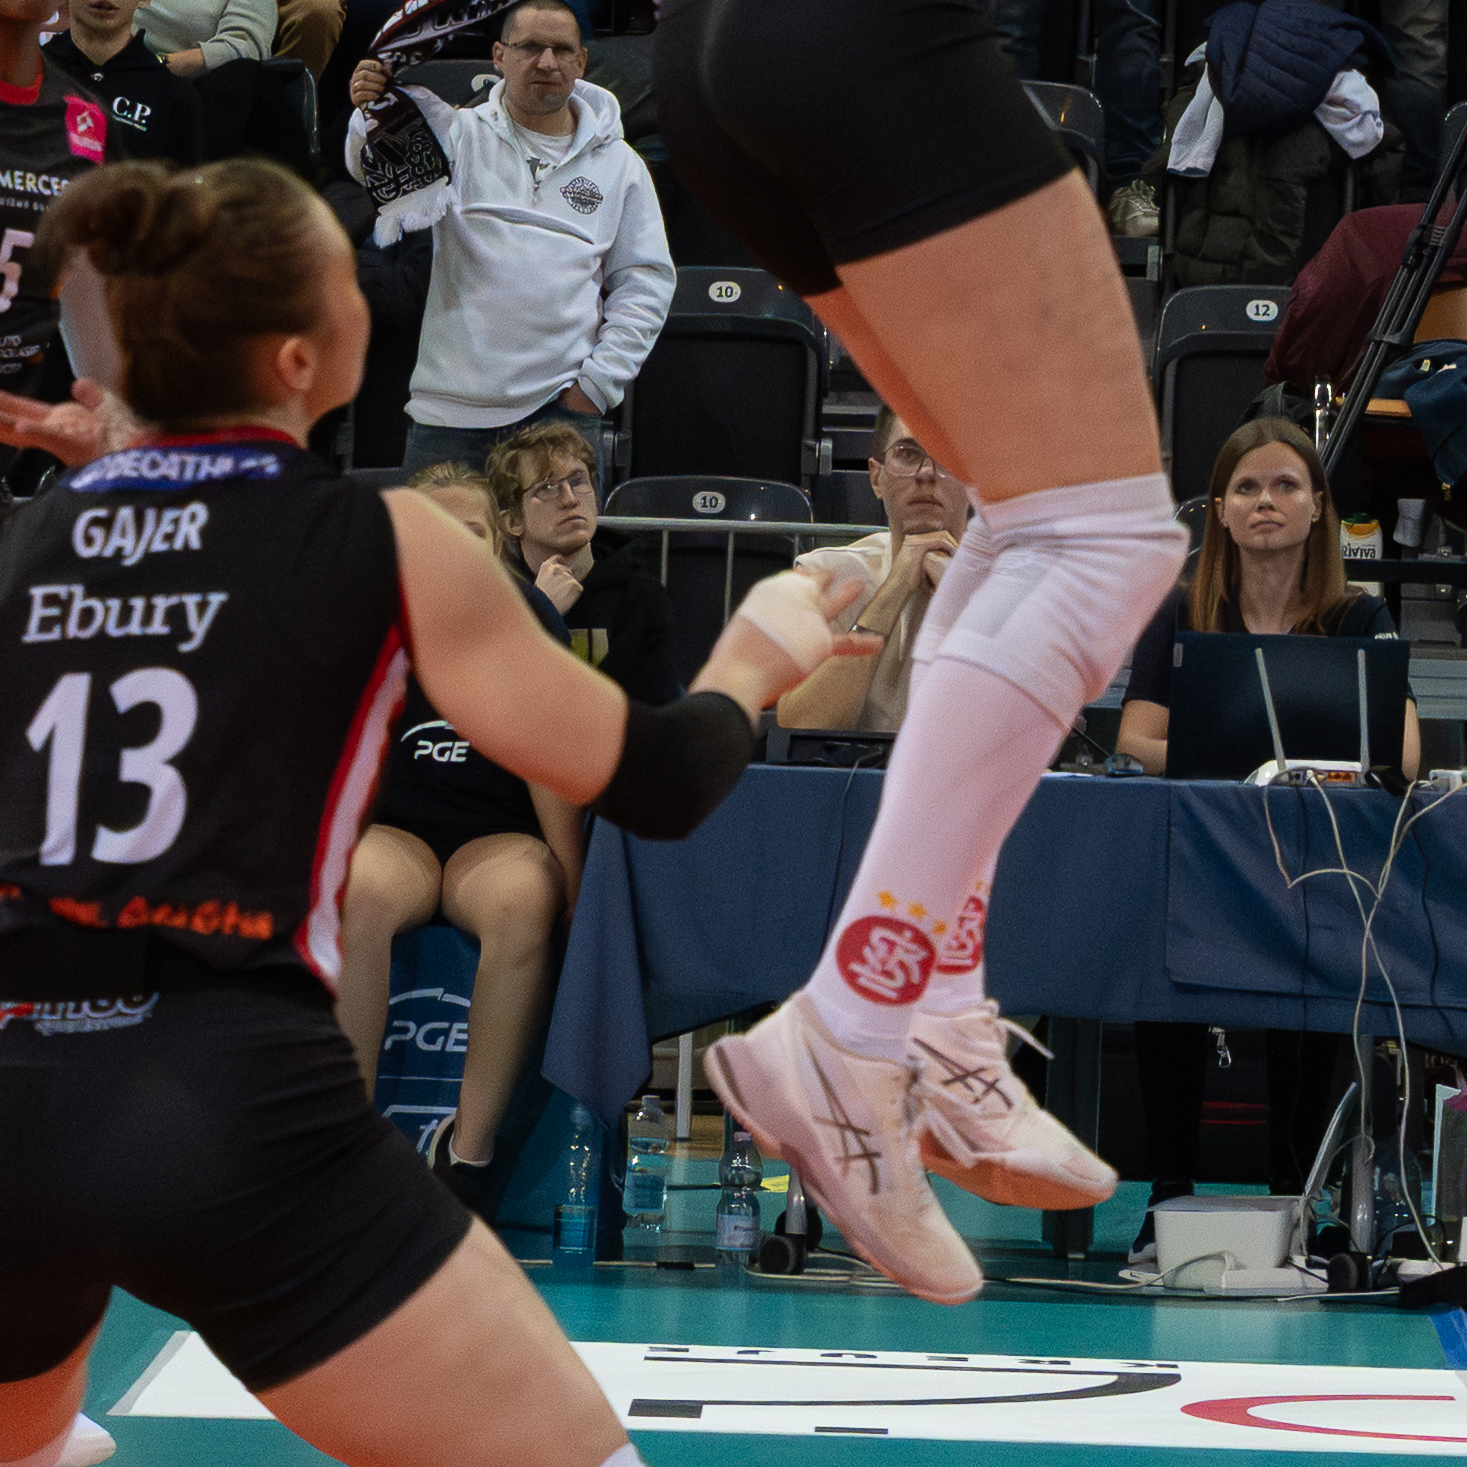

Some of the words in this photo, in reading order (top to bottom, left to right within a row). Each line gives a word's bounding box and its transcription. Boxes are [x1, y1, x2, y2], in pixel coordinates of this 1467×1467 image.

[717, 285, 734, 298] 10
[1254, 304, 1271, 317] 12
[701, 495, 719, 509] 10
[72, 501, 209, 566] GAJER
[22, 584, 229, 654] Ebury
[413, 739, 470, 763] PGE
[25, 666, 199, 866] 13
[384, 1020, 468, 1052] PGE
